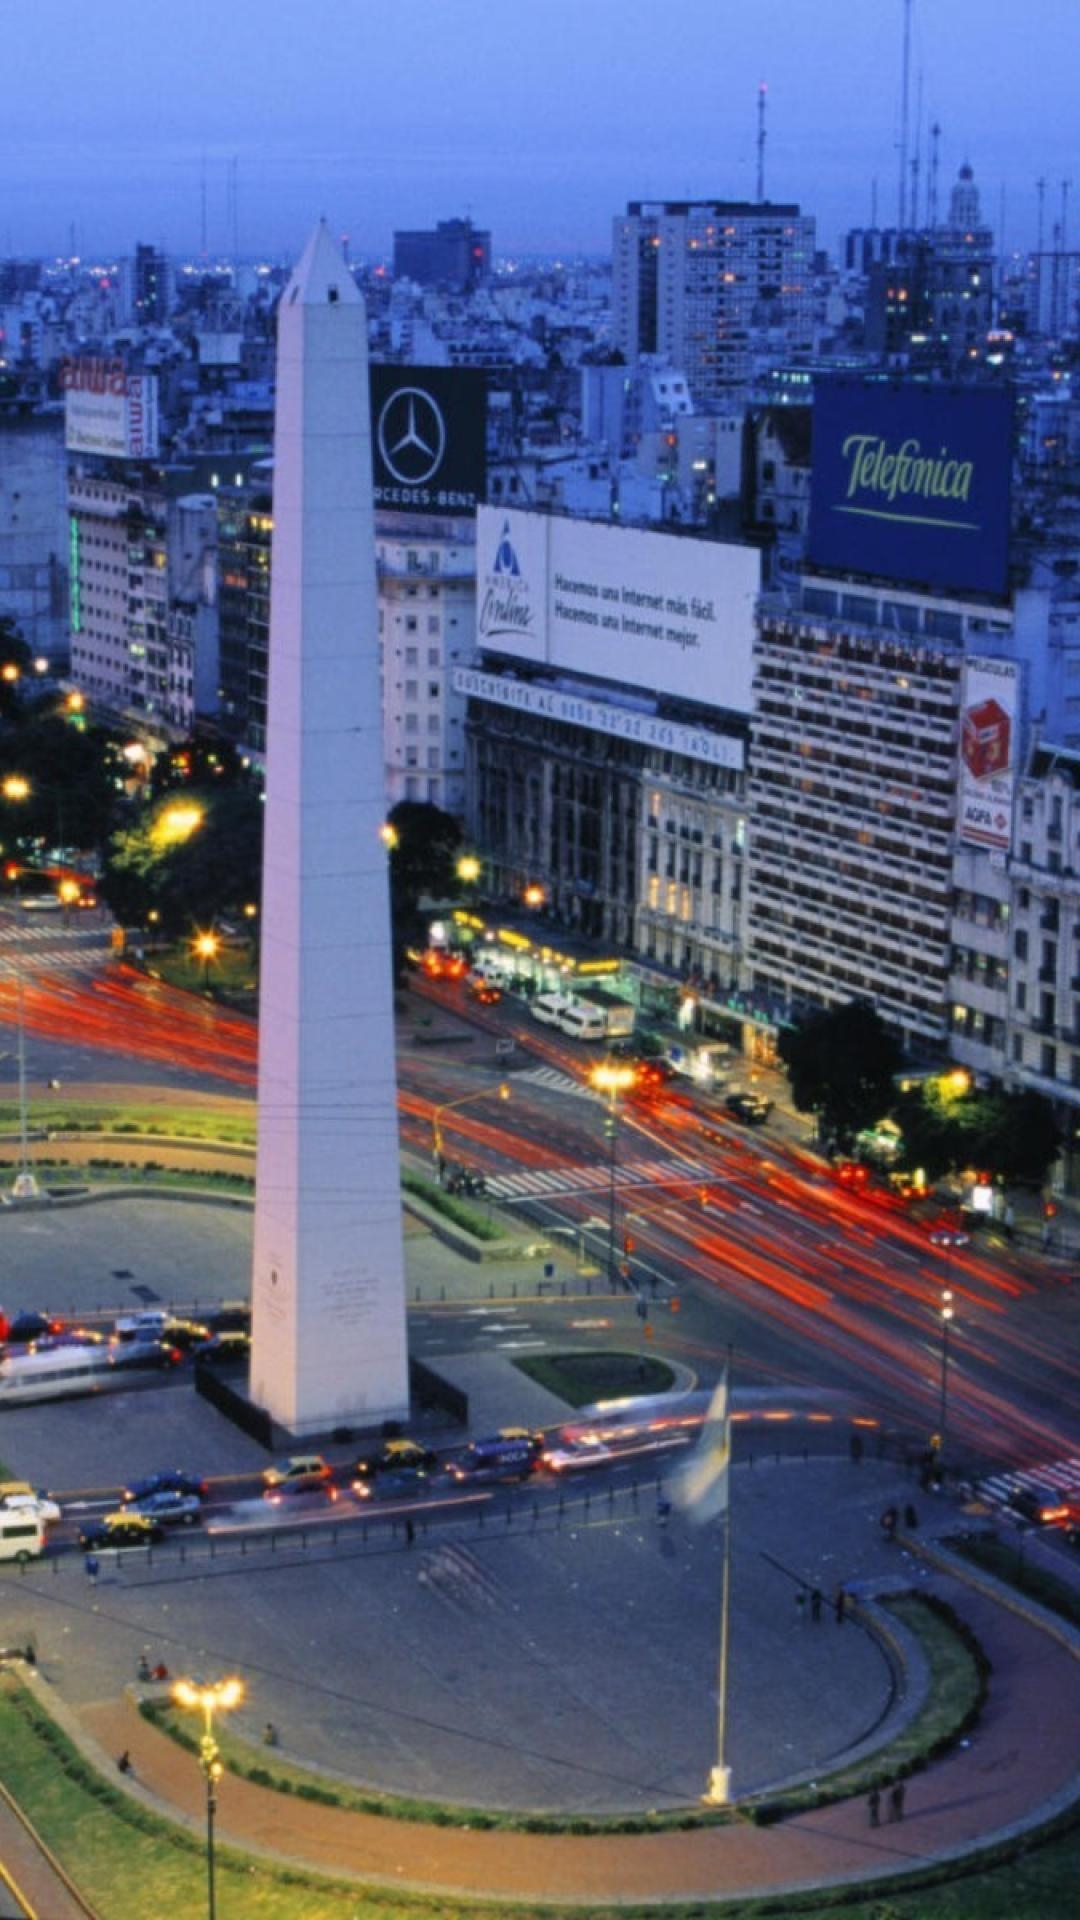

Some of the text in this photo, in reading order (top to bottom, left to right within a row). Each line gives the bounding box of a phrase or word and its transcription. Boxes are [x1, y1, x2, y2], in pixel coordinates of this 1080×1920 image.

[555, 573, 599, 598] Hacemos
[602, 587, 620, 602] una
[622, 586, 664, 611] Internet
[555, 600, 599, 626] Hacemos
[602, 615, 620, 631] una
[622, 614, 664, 640] Internet
